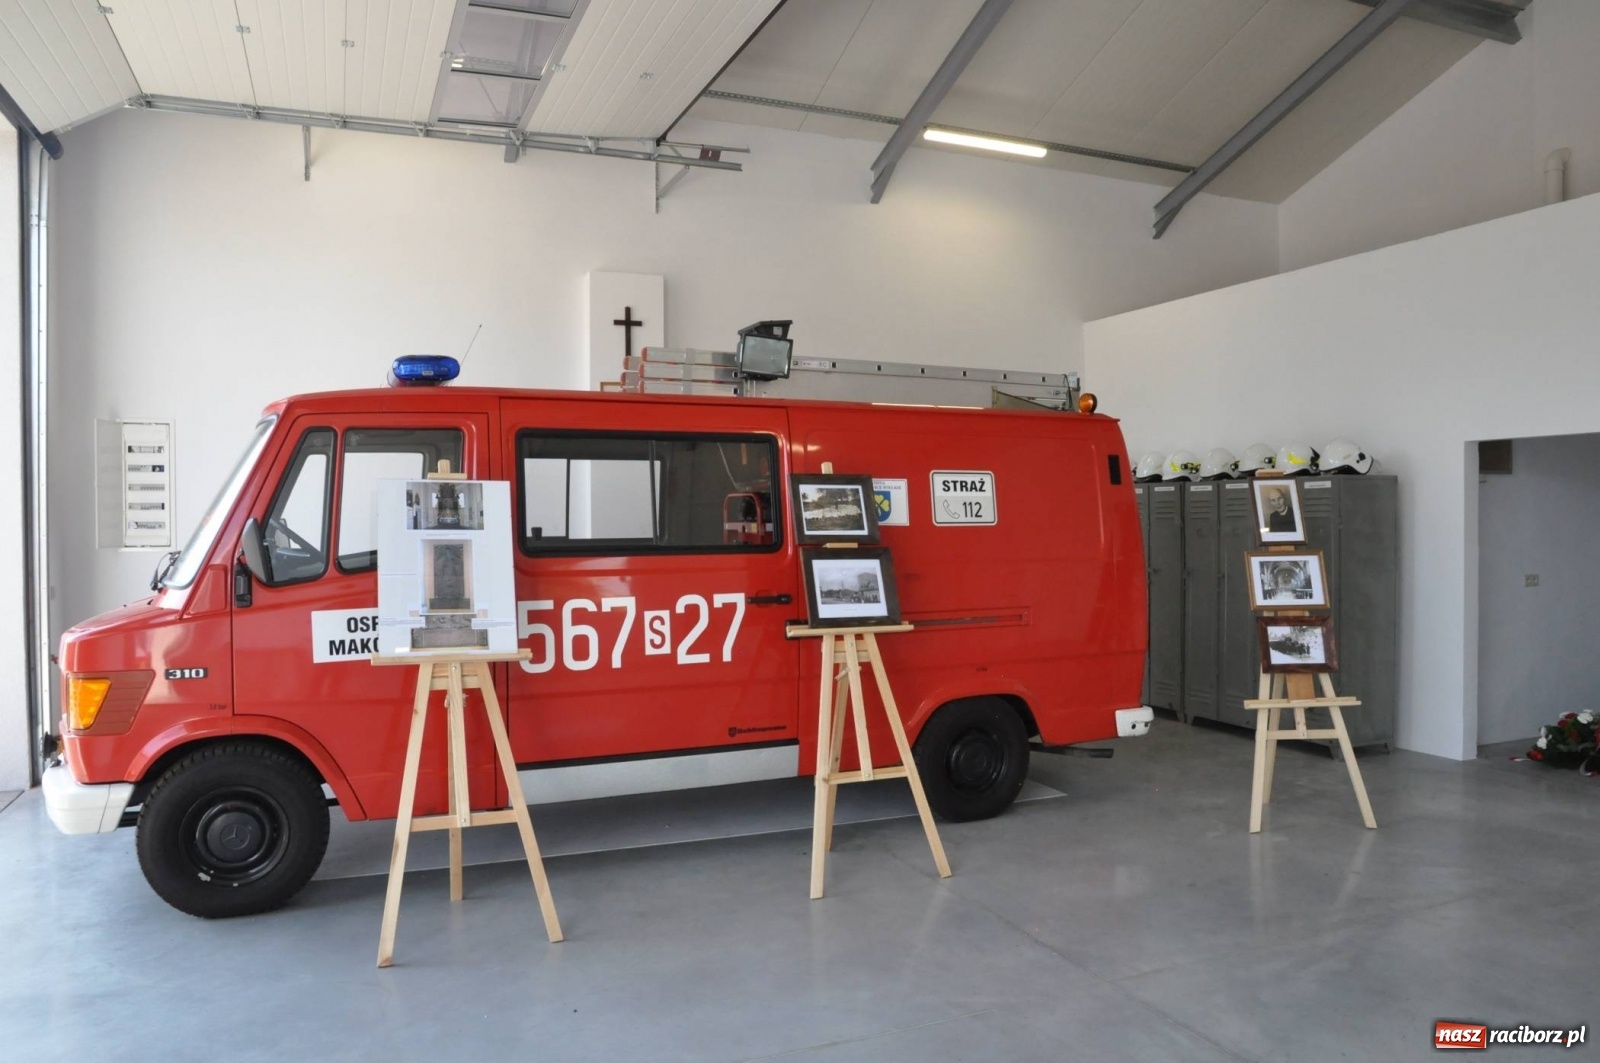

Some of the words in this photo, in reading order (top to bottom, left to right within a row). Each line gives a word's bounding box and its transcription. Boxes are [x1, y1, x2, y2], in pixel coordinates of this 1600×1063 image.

[942, 478, 986, 492] STRAŻ
[962, 501, 983, 518] 112
[168, 668, 204, 679] 310
